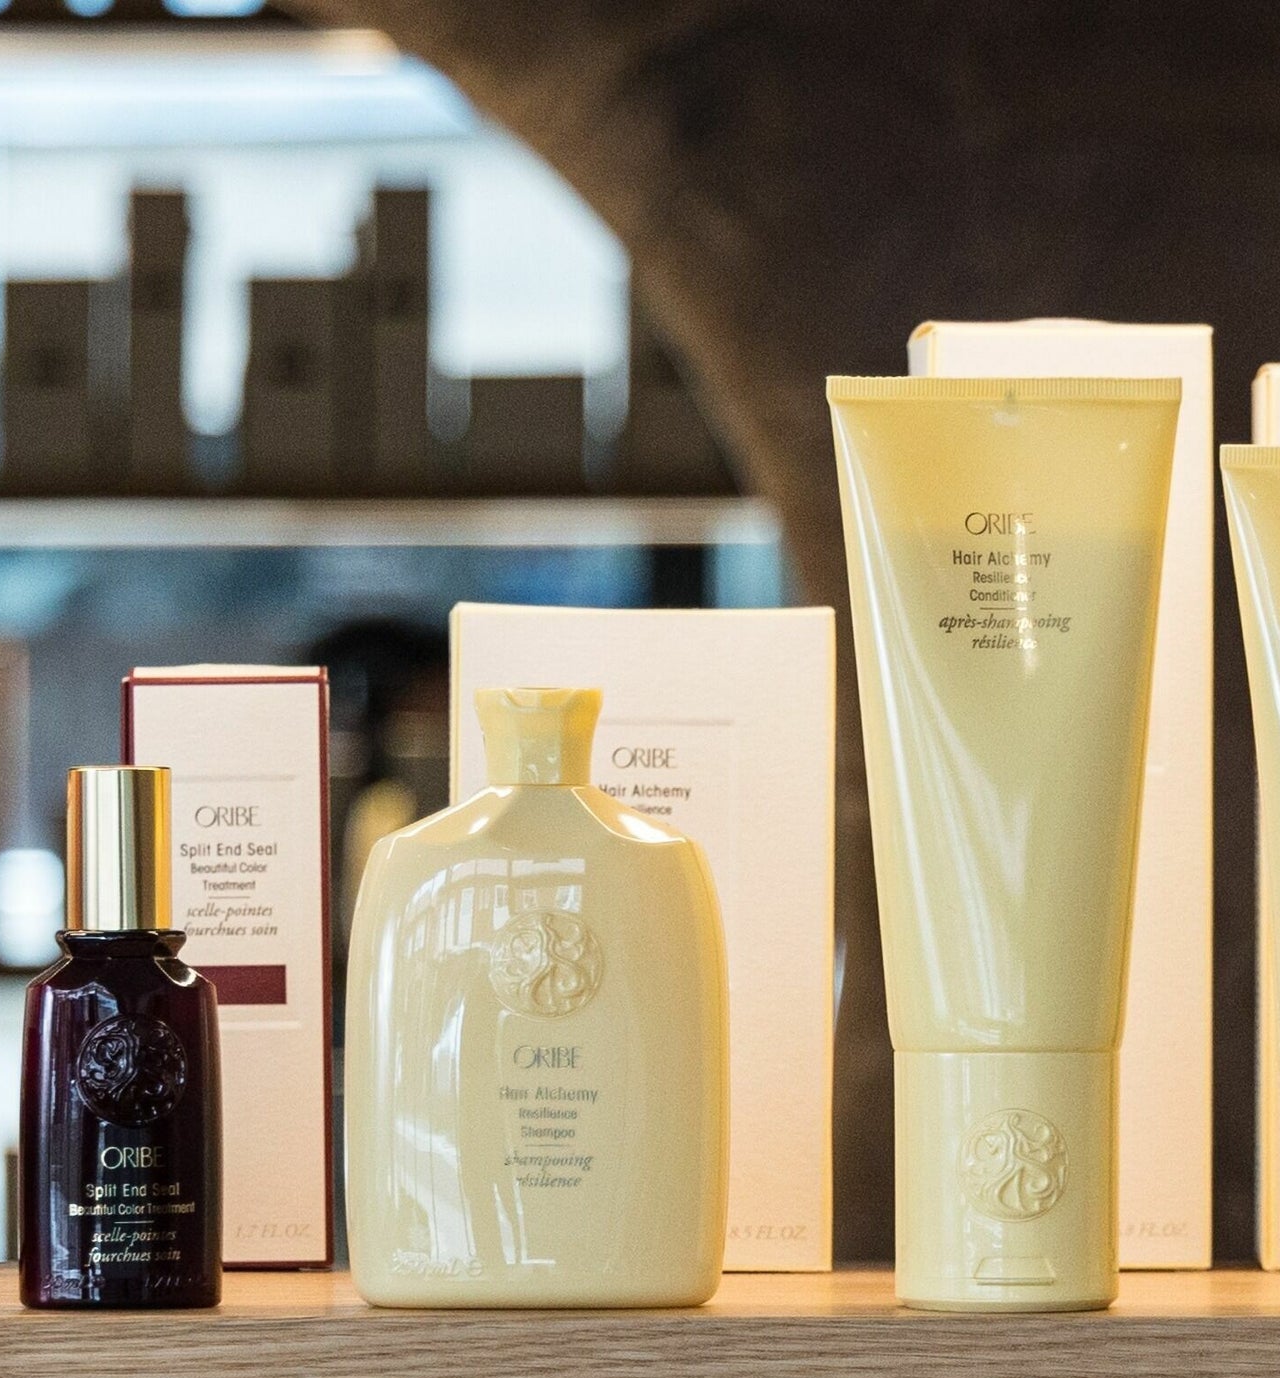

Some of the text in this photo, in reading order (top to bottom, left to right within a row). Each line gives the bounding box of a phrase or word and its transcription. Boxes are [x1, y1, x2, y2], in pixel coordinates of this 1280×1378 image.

[952, 550, 1051, 568] Hair Alcmy
[973, 571, 1031, 584] Resilie
[969, 589, 1037, 602] Conditior
[938, 613, 1072, 634] après-shampoing
[612, 746, 677, 769] ORIBE
[632, 783, 692, 802] Alchemy
[195, 805, 262, 828] ORIBE
[180, 842, 278, 859] Split End Seal
[191, 862, 268, 874] Beautiful Color
[204, 879, 257, 891] Treatment
[187, 902, 274, 922] scelle-pointes
[251, 922, 279, 936] soin
[513, 1045, 584, 1070] ORIBE
[535, 1086, 600, 1104] Alchemy
[101, 1146, 166, 1170] ORIBE
[86, 1182, 180, 1201] Split End Sal
[69, 1203, 116, 1217] Beautiful
[118, 1203, 145, 1216] Color
[92, 1226, 177, 1247] scelle-poines
[84, 1246, 151, 1268] fourchues
